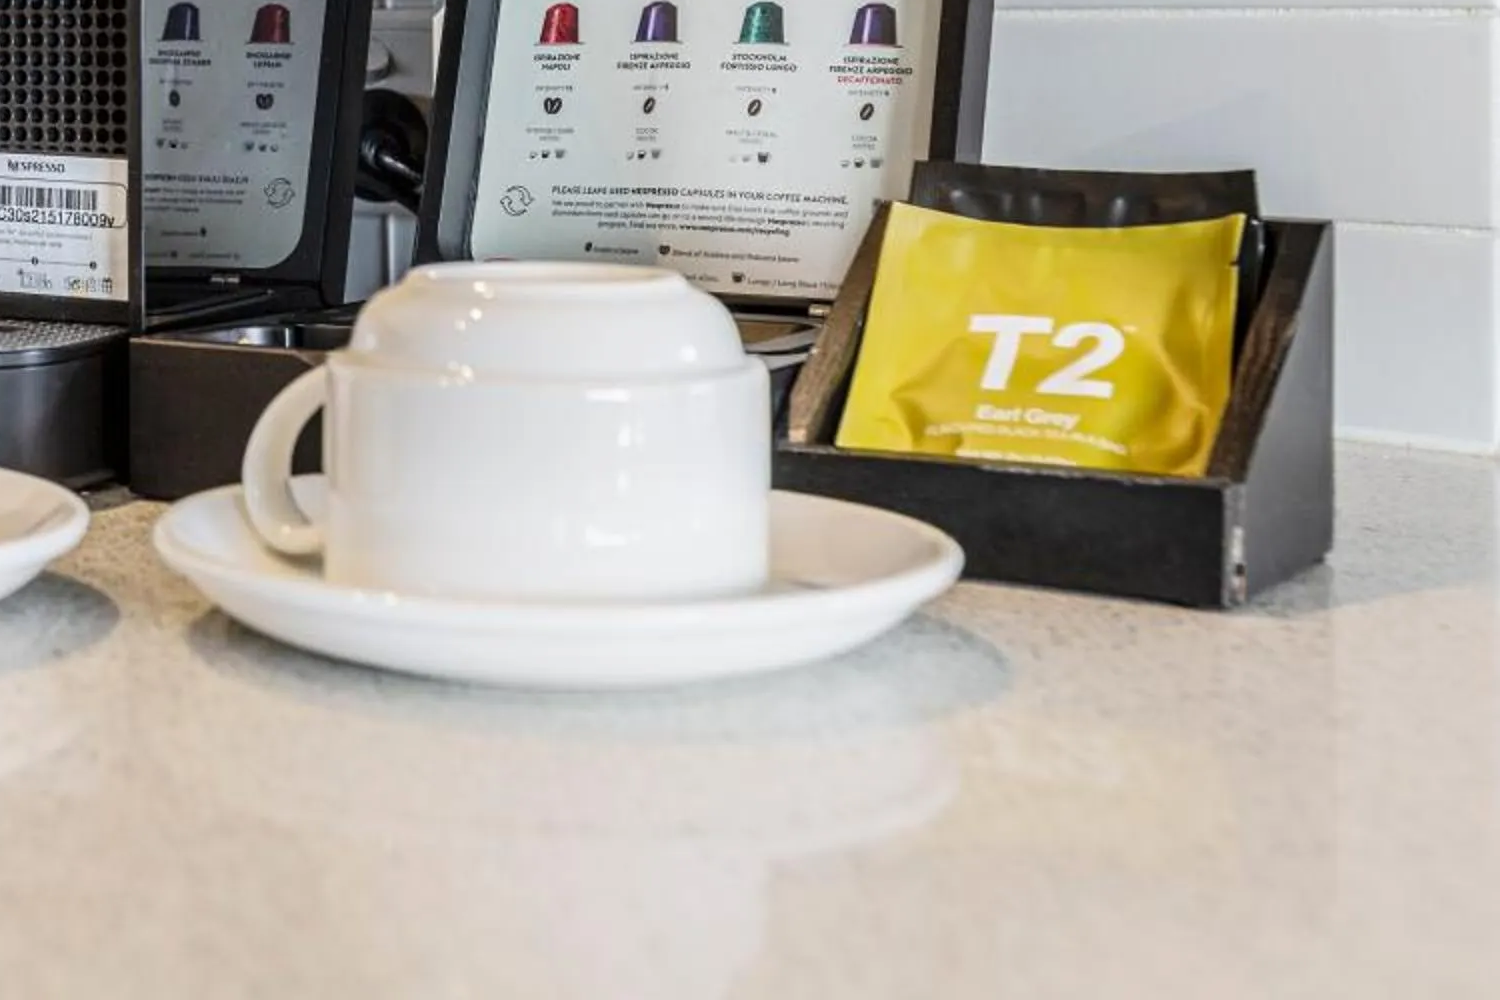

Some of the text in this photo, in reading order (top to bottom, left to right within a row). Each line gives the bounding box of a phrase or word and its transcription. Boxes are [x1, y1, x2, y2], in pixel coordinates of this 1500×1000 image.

[8, 159, 65, 173] NESPRESSO
[552, 186, 581, 195] PLEASE
[738, 190, 765, 201] YOUR
[766, 192, 802, 202] COFFEE
[968, 313, 1126, 399] T2
[975, 403, 1081, 431] Earl Grey
